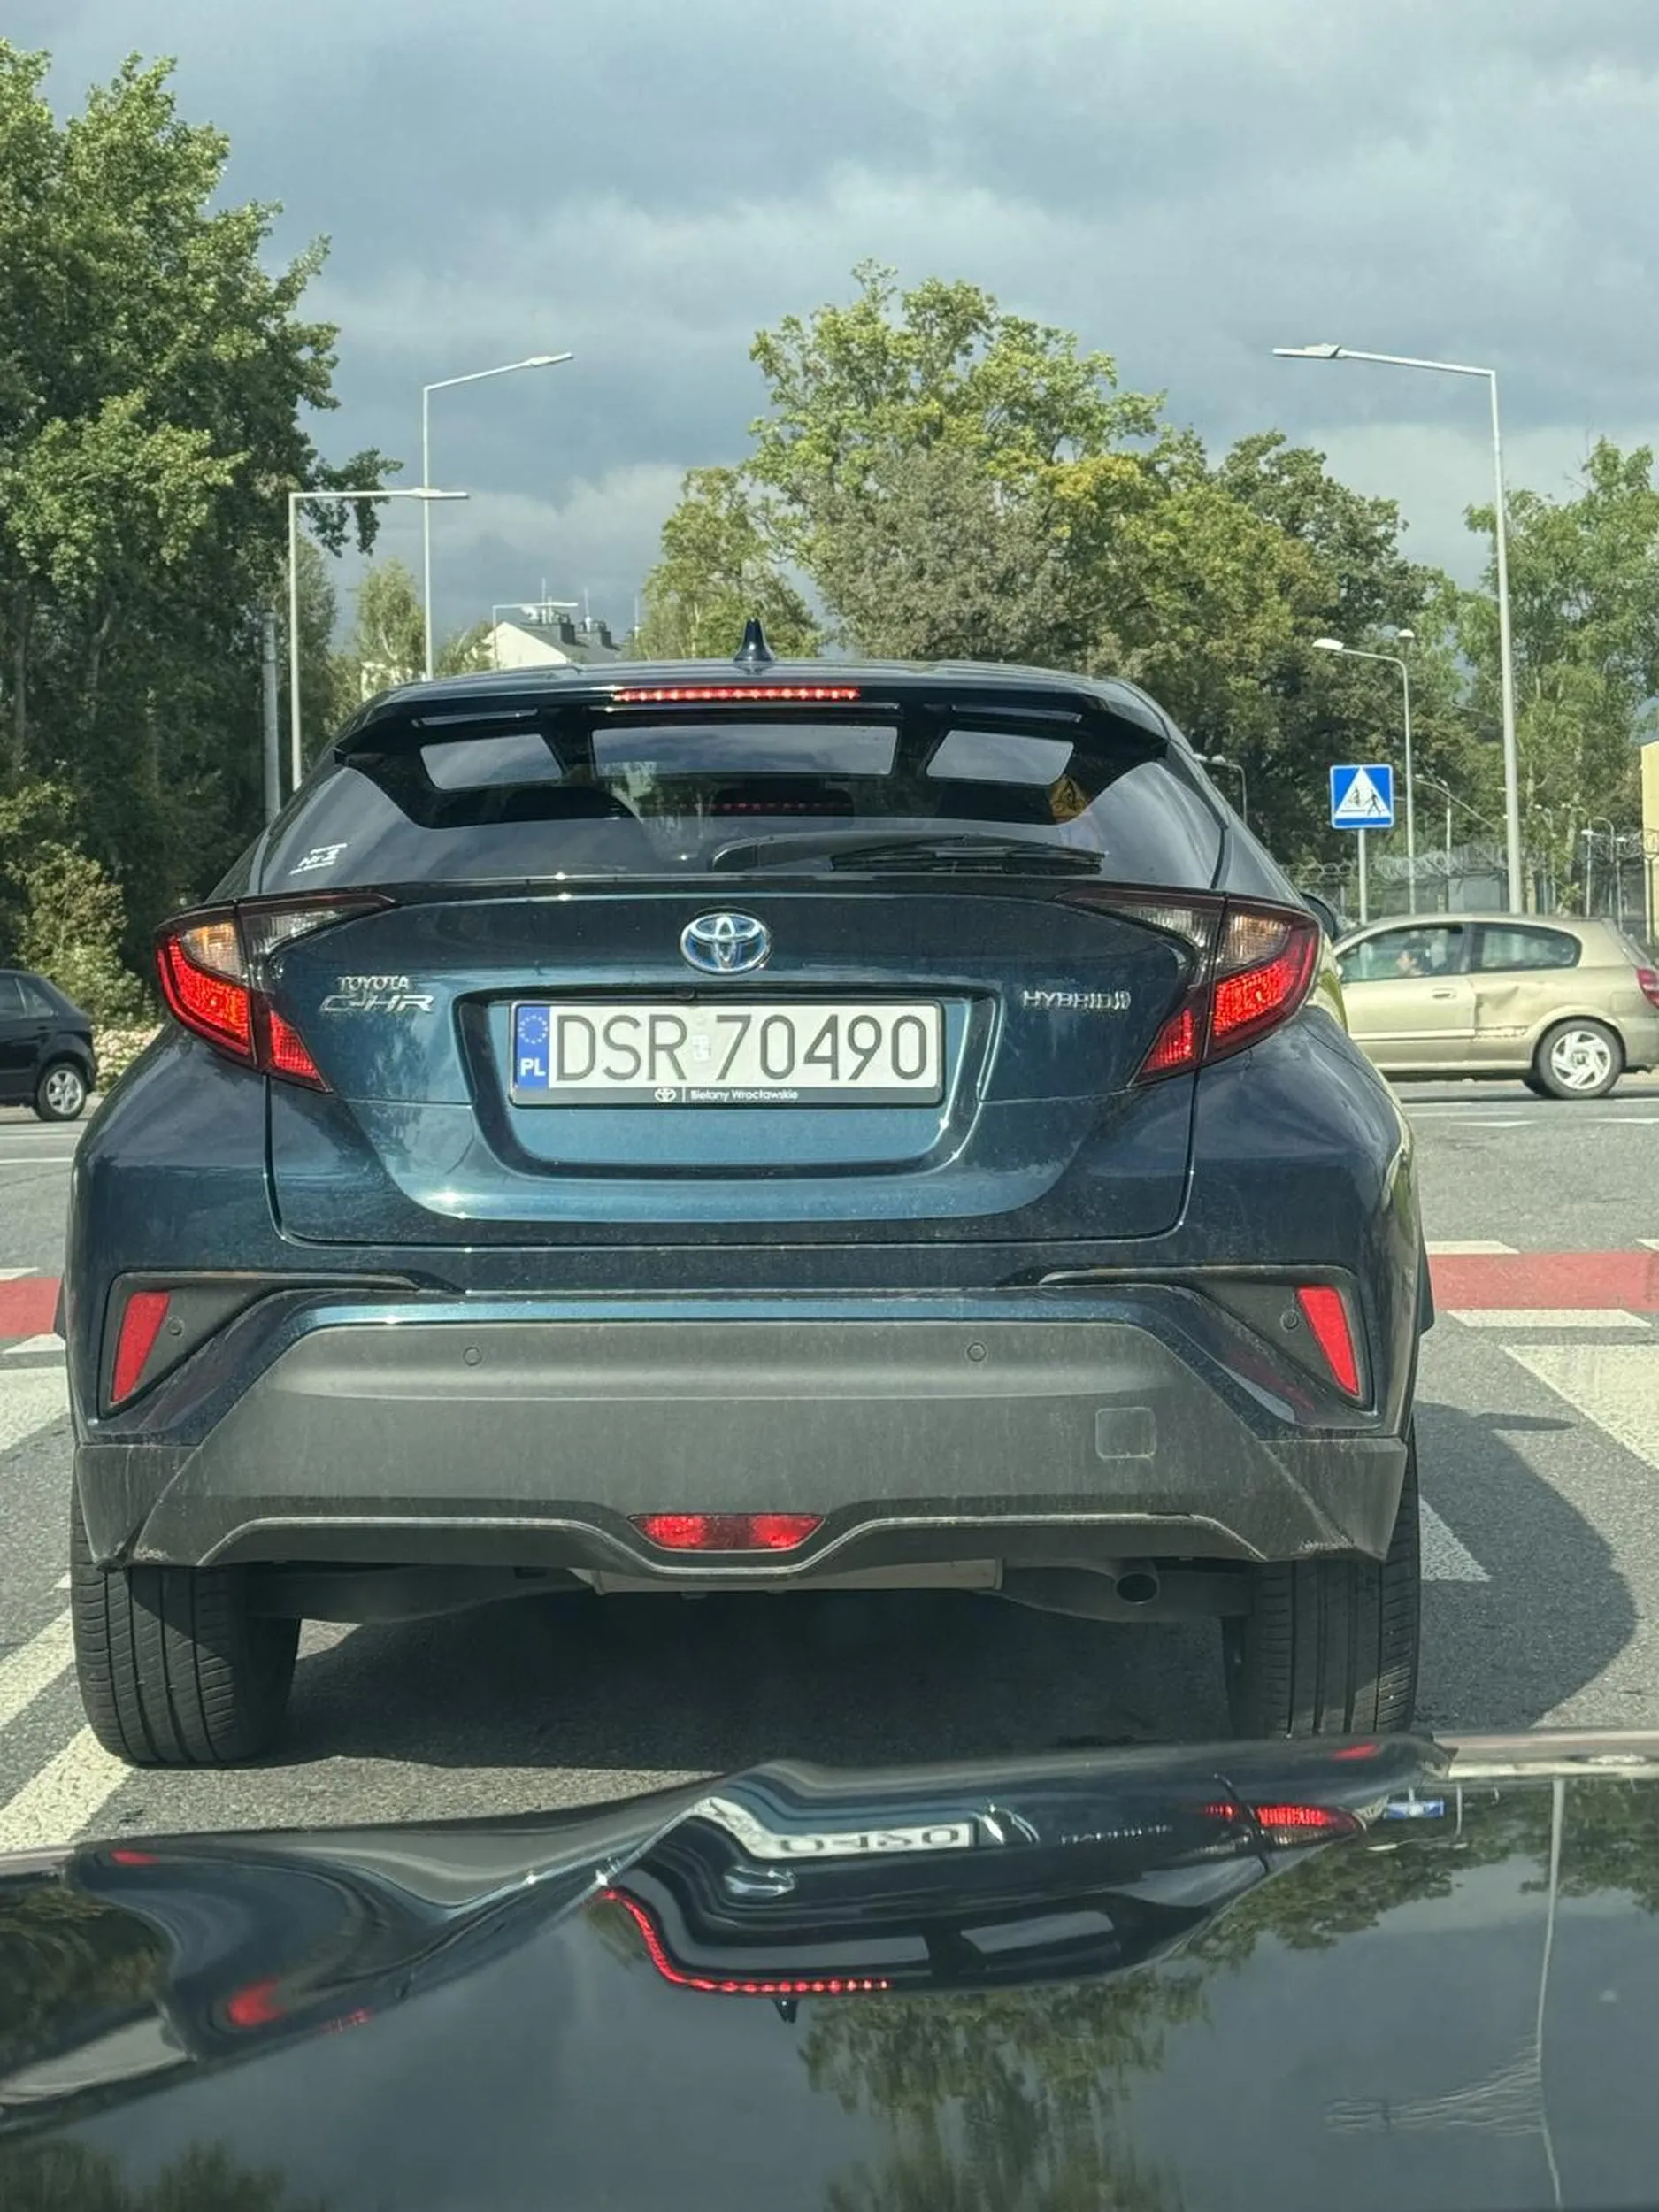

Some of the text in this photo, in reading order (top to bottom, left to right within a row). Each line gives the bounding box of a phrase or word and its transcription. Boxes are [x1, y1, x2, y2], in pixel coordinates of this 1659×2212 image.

[336, 975, 410, 991] TOYOTA
[1023, 990, 1111, 1009] HYBRID
[557, 1014, 928, 1081] DSR 70490
[520, 1057, 546, 1077] PL
[690, 1090, 729, 1102] Bielany
